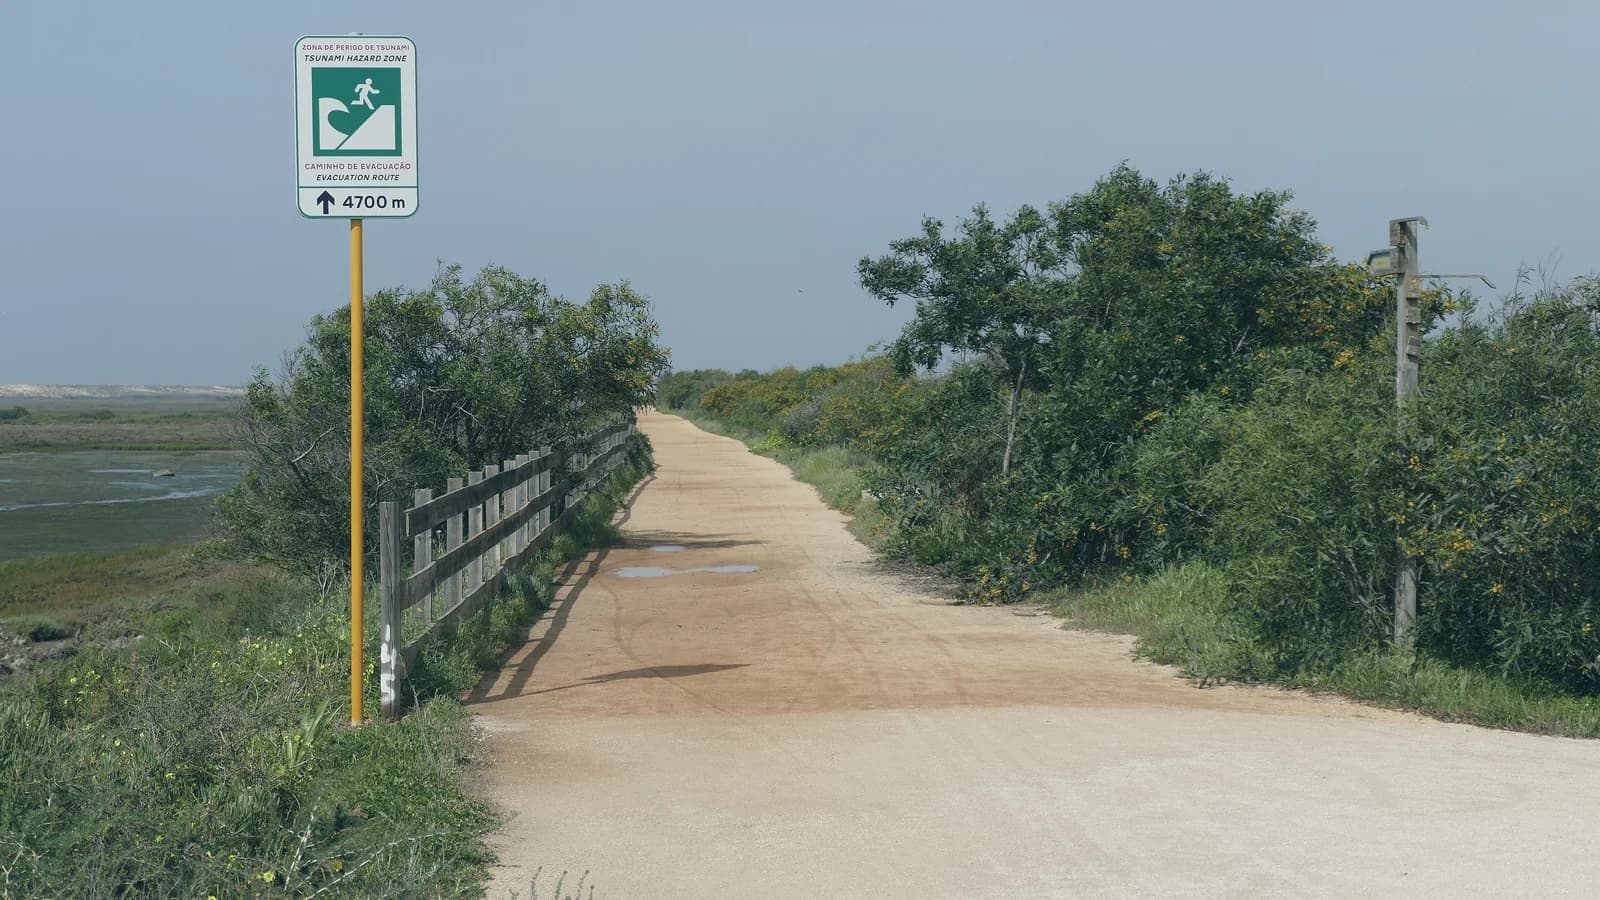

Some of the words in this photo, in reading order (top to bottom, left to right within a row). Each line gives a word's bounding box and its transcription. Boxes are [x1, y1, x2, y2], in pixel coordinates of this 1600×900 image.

[361, 162, 411, 170] EVACUAÇÃO
[343, 196, 387, 208] 4700
[392, 198, 405, 208] m
